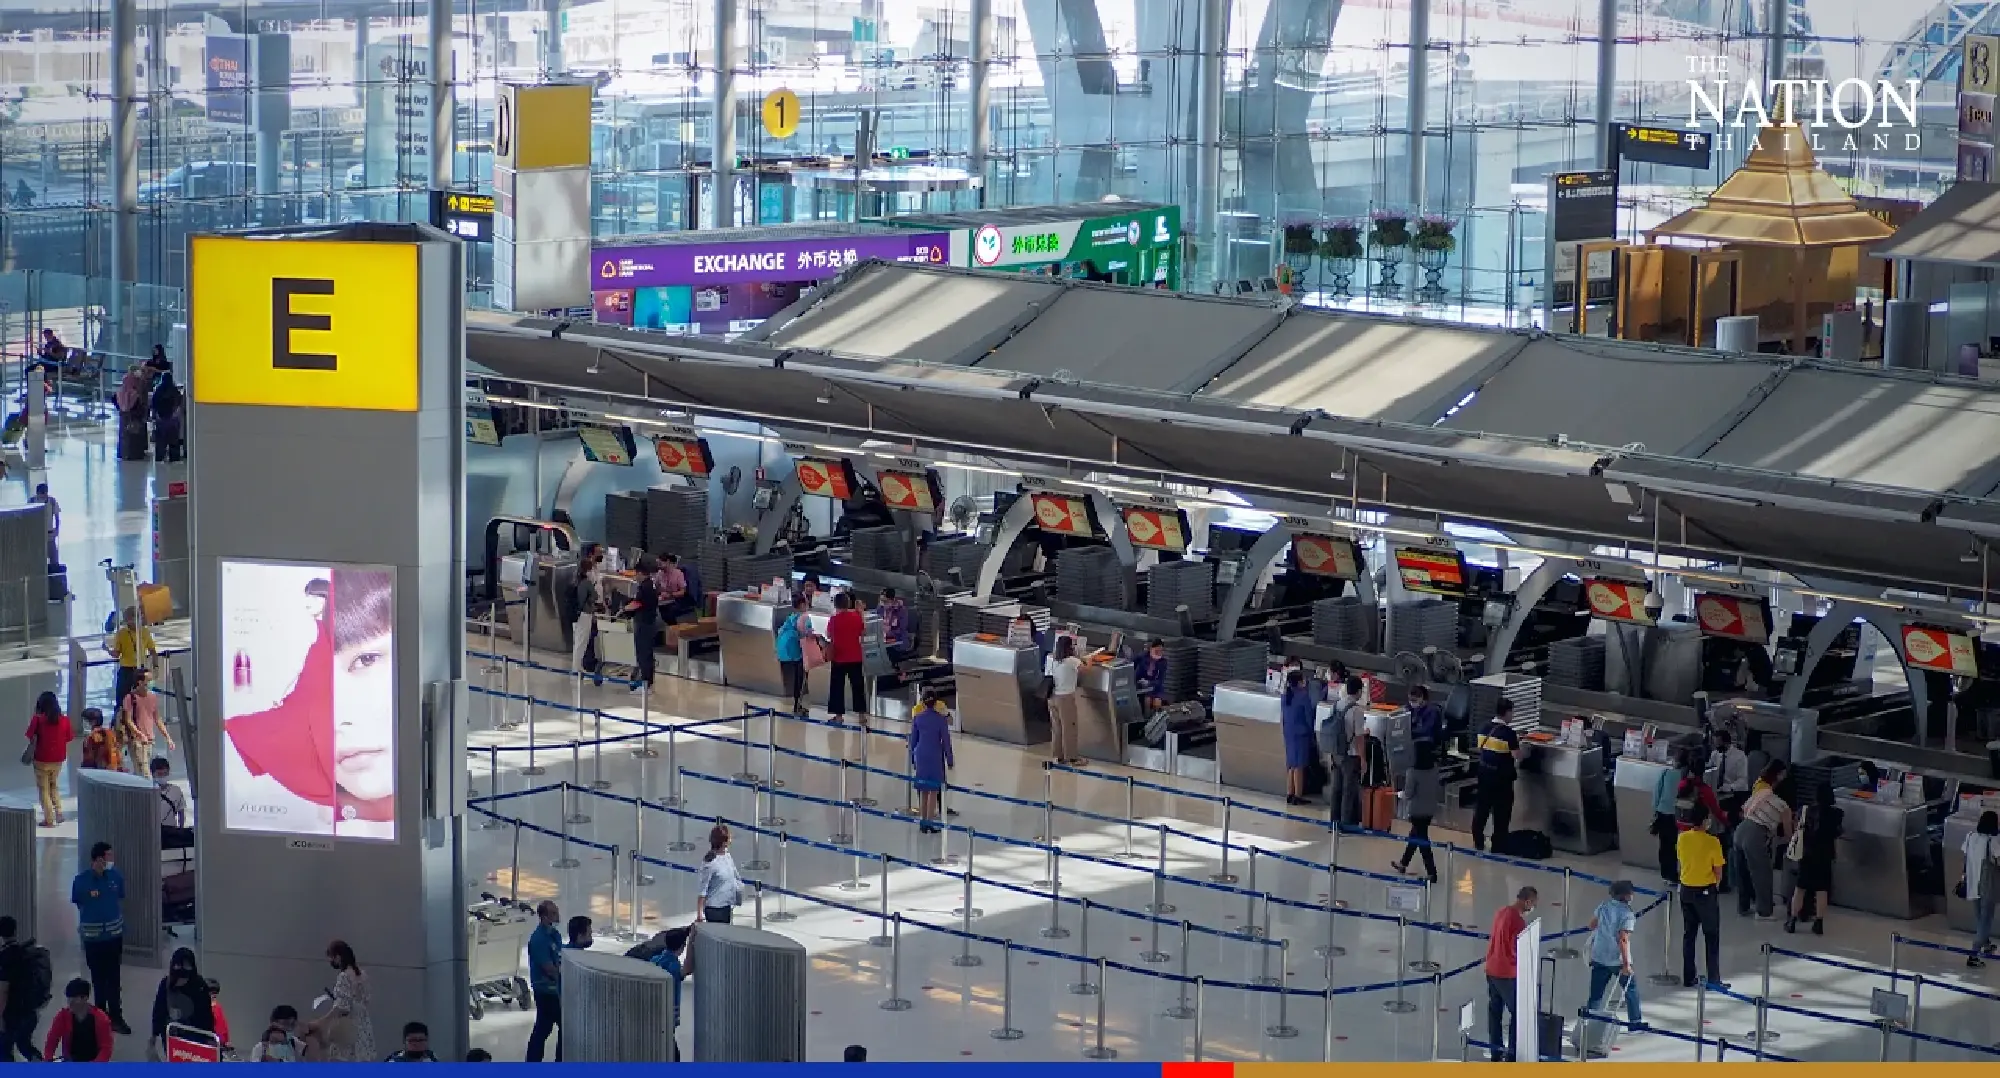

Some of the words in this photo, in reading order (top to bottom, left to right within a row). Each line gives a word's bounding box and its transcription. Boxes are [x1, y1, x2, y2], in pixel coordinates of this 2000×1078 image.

[775, 97, 785, 129] 1
[694, 252, 786, 274] EXCHANGE
[271, 277, 338, 371] E
